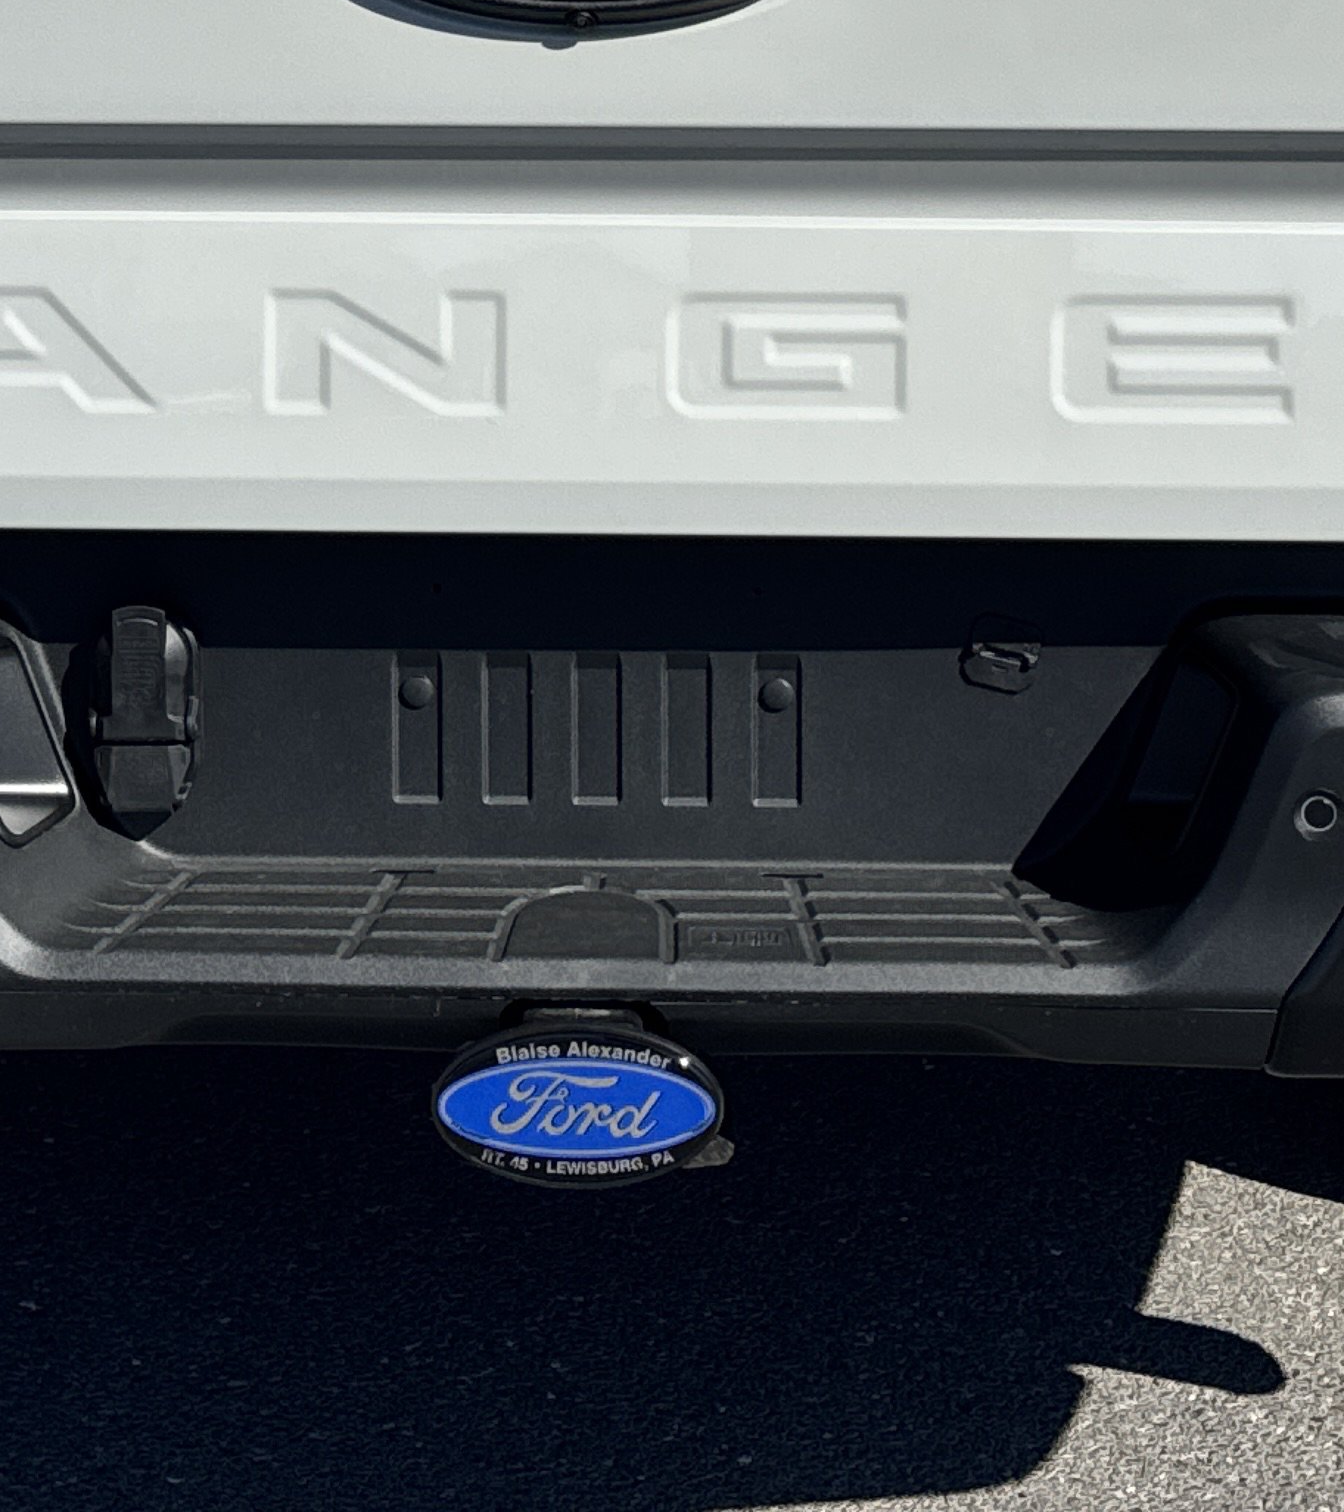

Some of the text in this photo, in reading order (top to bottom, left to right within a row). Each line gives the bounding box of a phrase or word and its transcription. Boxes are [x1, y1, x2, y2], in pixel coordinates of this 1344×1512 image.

[495, 1040, 672, 1070] Blaise Alexander
[489, 1070, 661, 1139] Ford
[509, 1156, 530, 1172] 45
[545, 1157, 650, 1176] LEWISBURG,
[651, 1149, 675, 1168] PA
